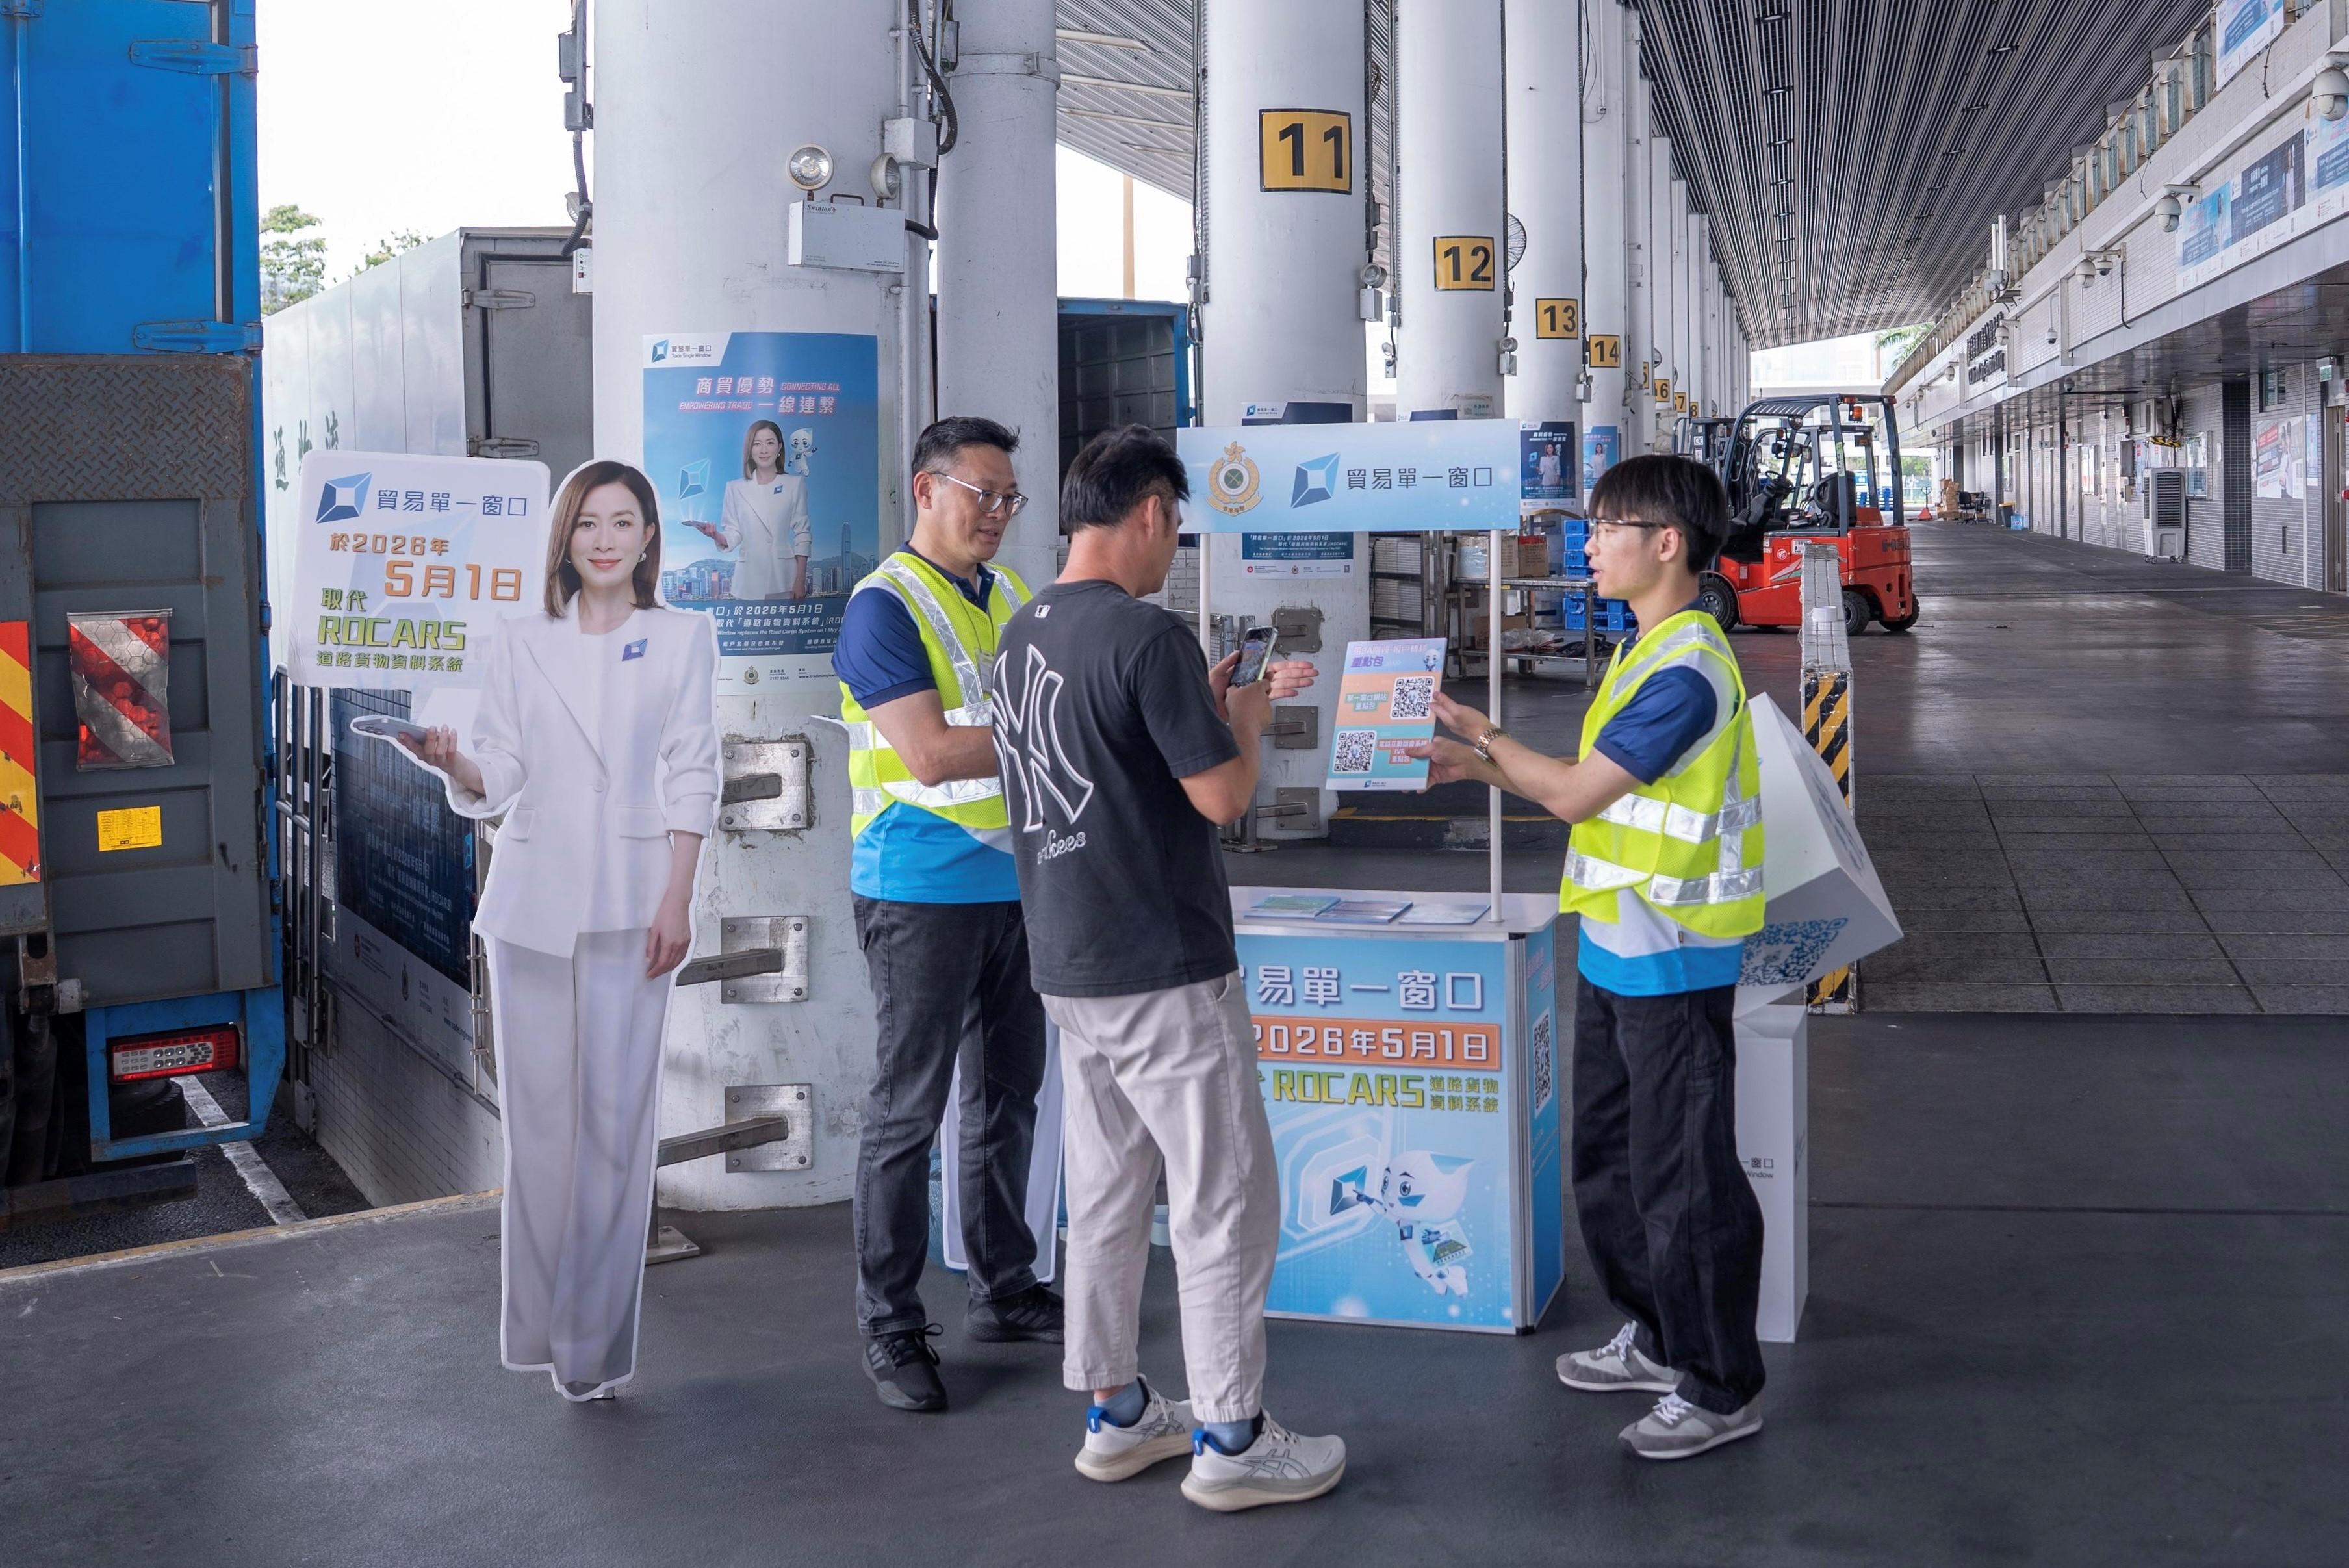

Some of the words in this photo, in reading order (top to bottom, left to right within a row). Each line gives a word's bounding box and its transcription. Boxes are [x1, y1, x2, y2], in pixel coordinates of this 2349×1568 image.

[1279, 123, 1344, 179] 11
[807, 203, 832, 212] Swinton
[1443, 245, 1491, 283] 12
[1543, 304, 1576, 333] 13
[1595, 340, 1619, 363] 14
[696, 376, 774, 394] 商貿優勢
[679, 402, 726, 410] EMPOWERING
[727, 401, 752, 409] TRADE
[1347, 466, 1493, 491] 貿易單一窗口
[376, 489, 527, 517] 貿易單一窗口
[329, 533, 450, 556] 於2026年
[384, 560, 522, 602] 5月1日
[322, 587, 368, 612] 取代
[317, 615, 467, 650] ROCARS
[316, 650, 464, 673] 道路貨物資料系統
[1239, 964, 1484, 1011] 易單一窗口
[1272, 1068, 1424, 1107] ROCARS
[1430, 1075, 1498, 1094] 道路貨物
[1430, 1094, 1498, 1112] 資料系統
